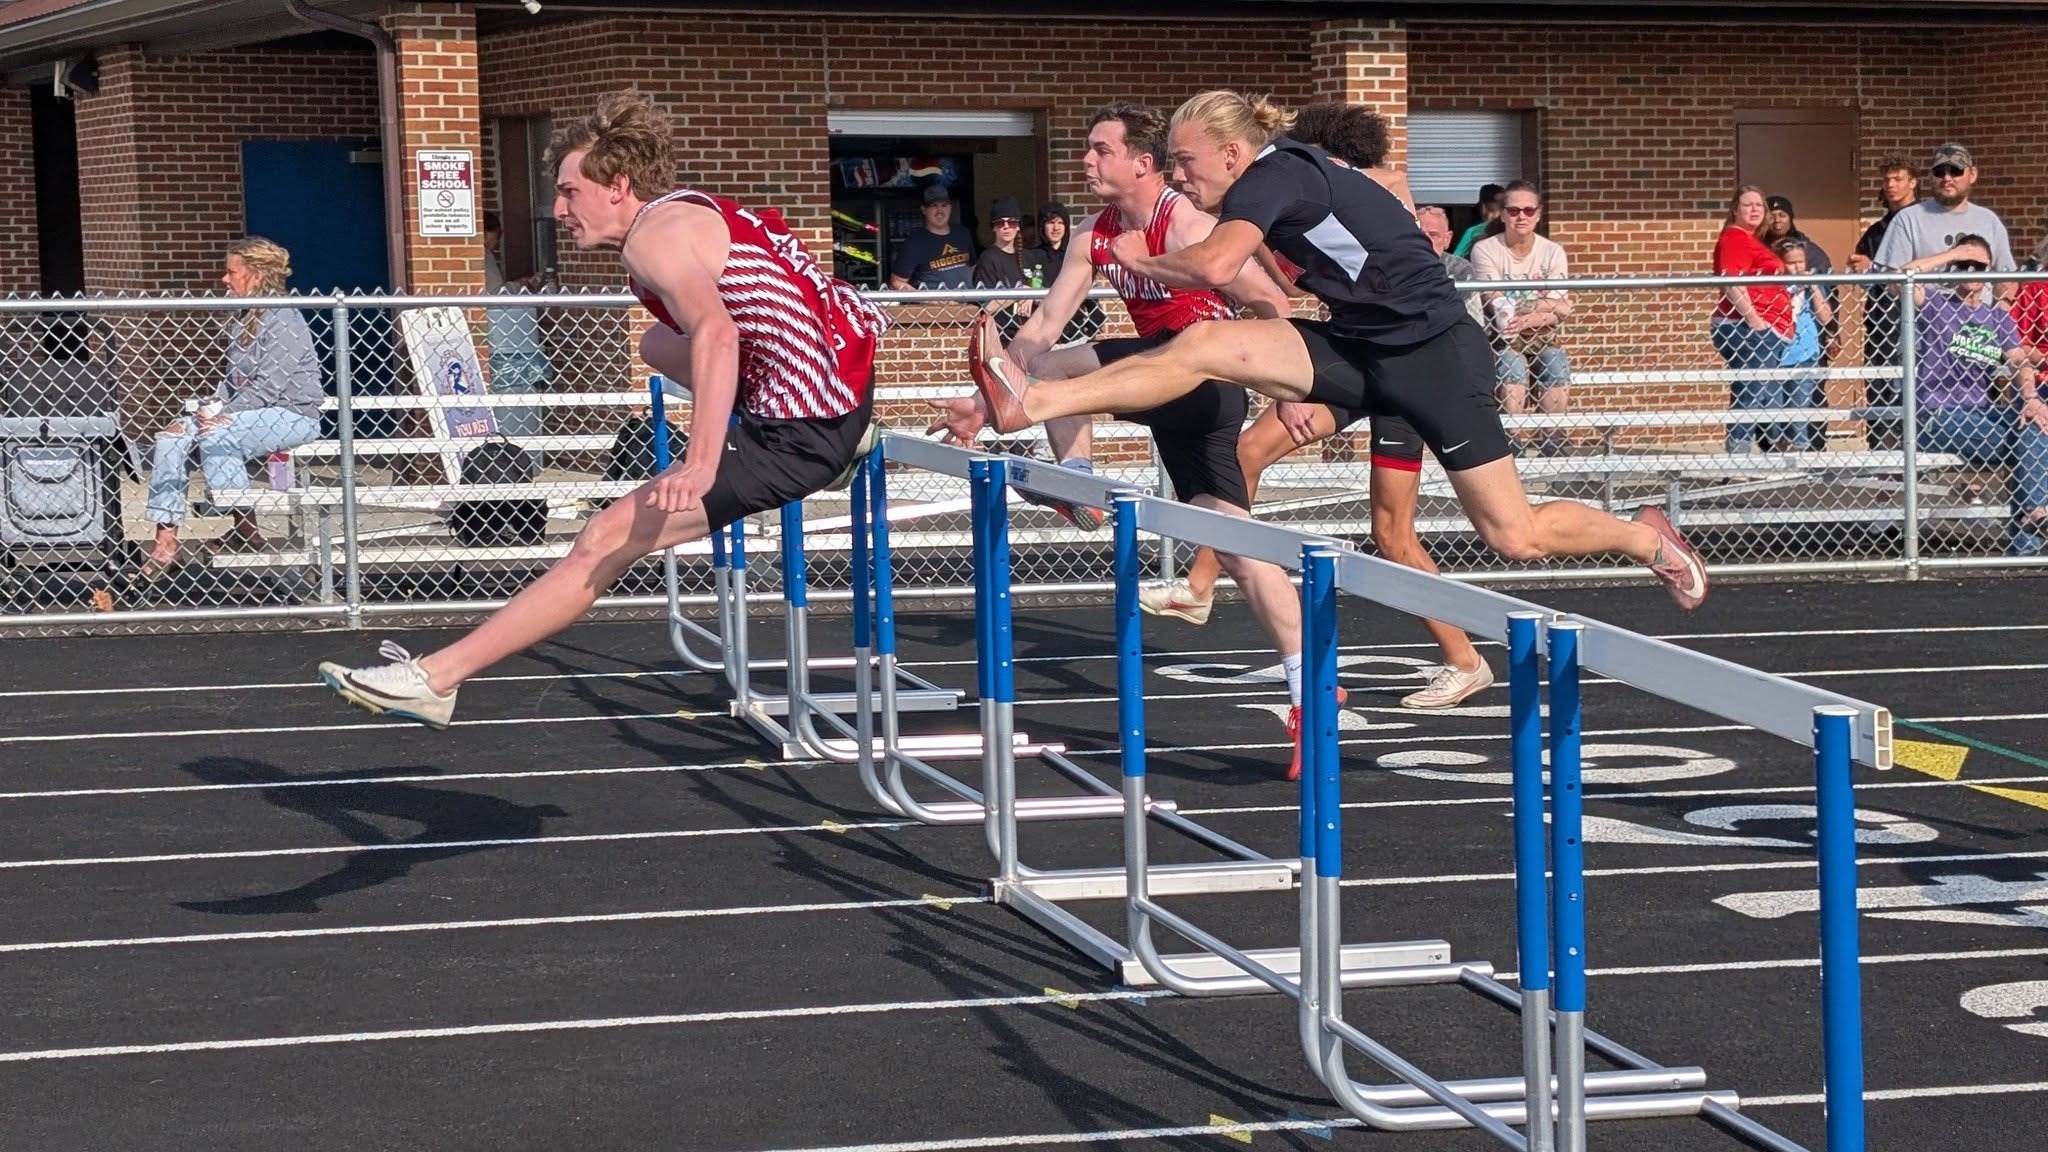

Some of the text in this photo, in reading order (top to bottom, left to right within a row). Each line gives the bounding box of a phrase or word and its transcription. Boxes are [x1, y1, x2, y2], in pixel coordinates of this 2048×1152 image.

[423, 162, 466, 171] SMOKE
[430, 171, 461, 179] FREE
[421, 179, 469, 188] SCHOOL
